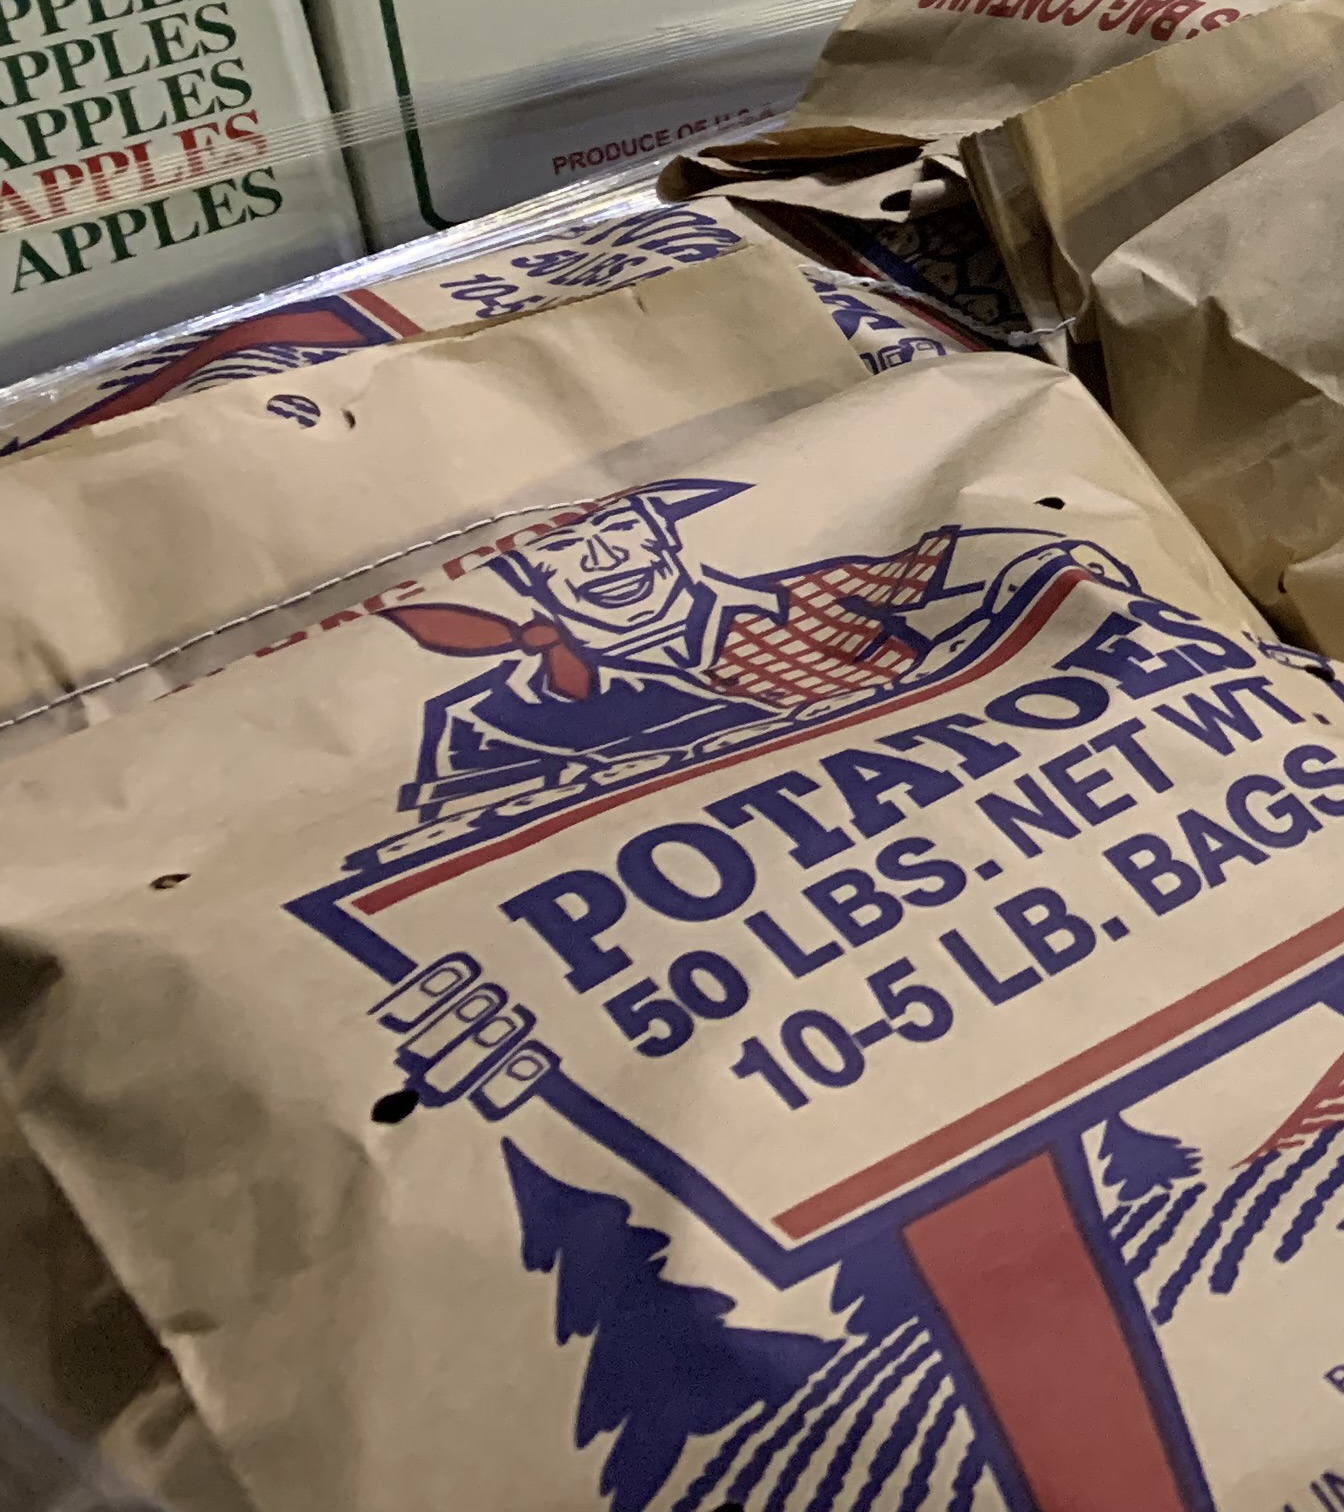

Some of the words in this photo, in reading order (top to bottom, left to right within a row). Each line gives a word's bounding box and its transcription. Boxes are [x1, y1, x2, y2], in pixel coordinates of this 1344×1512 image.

[11, 166, 283, 294] APPLES
[499, 598, 1260, 995] POTATOES
[601, 950, 750, 1058] 50
[743, 836, 1005, 979] LBS.
[975, 719, 1176, 858] NET
[1161, 674, 1331, 756] WT.
[730, 958, 954, 1110] 10-5
[940, 887, 1131, 1006] LB.
